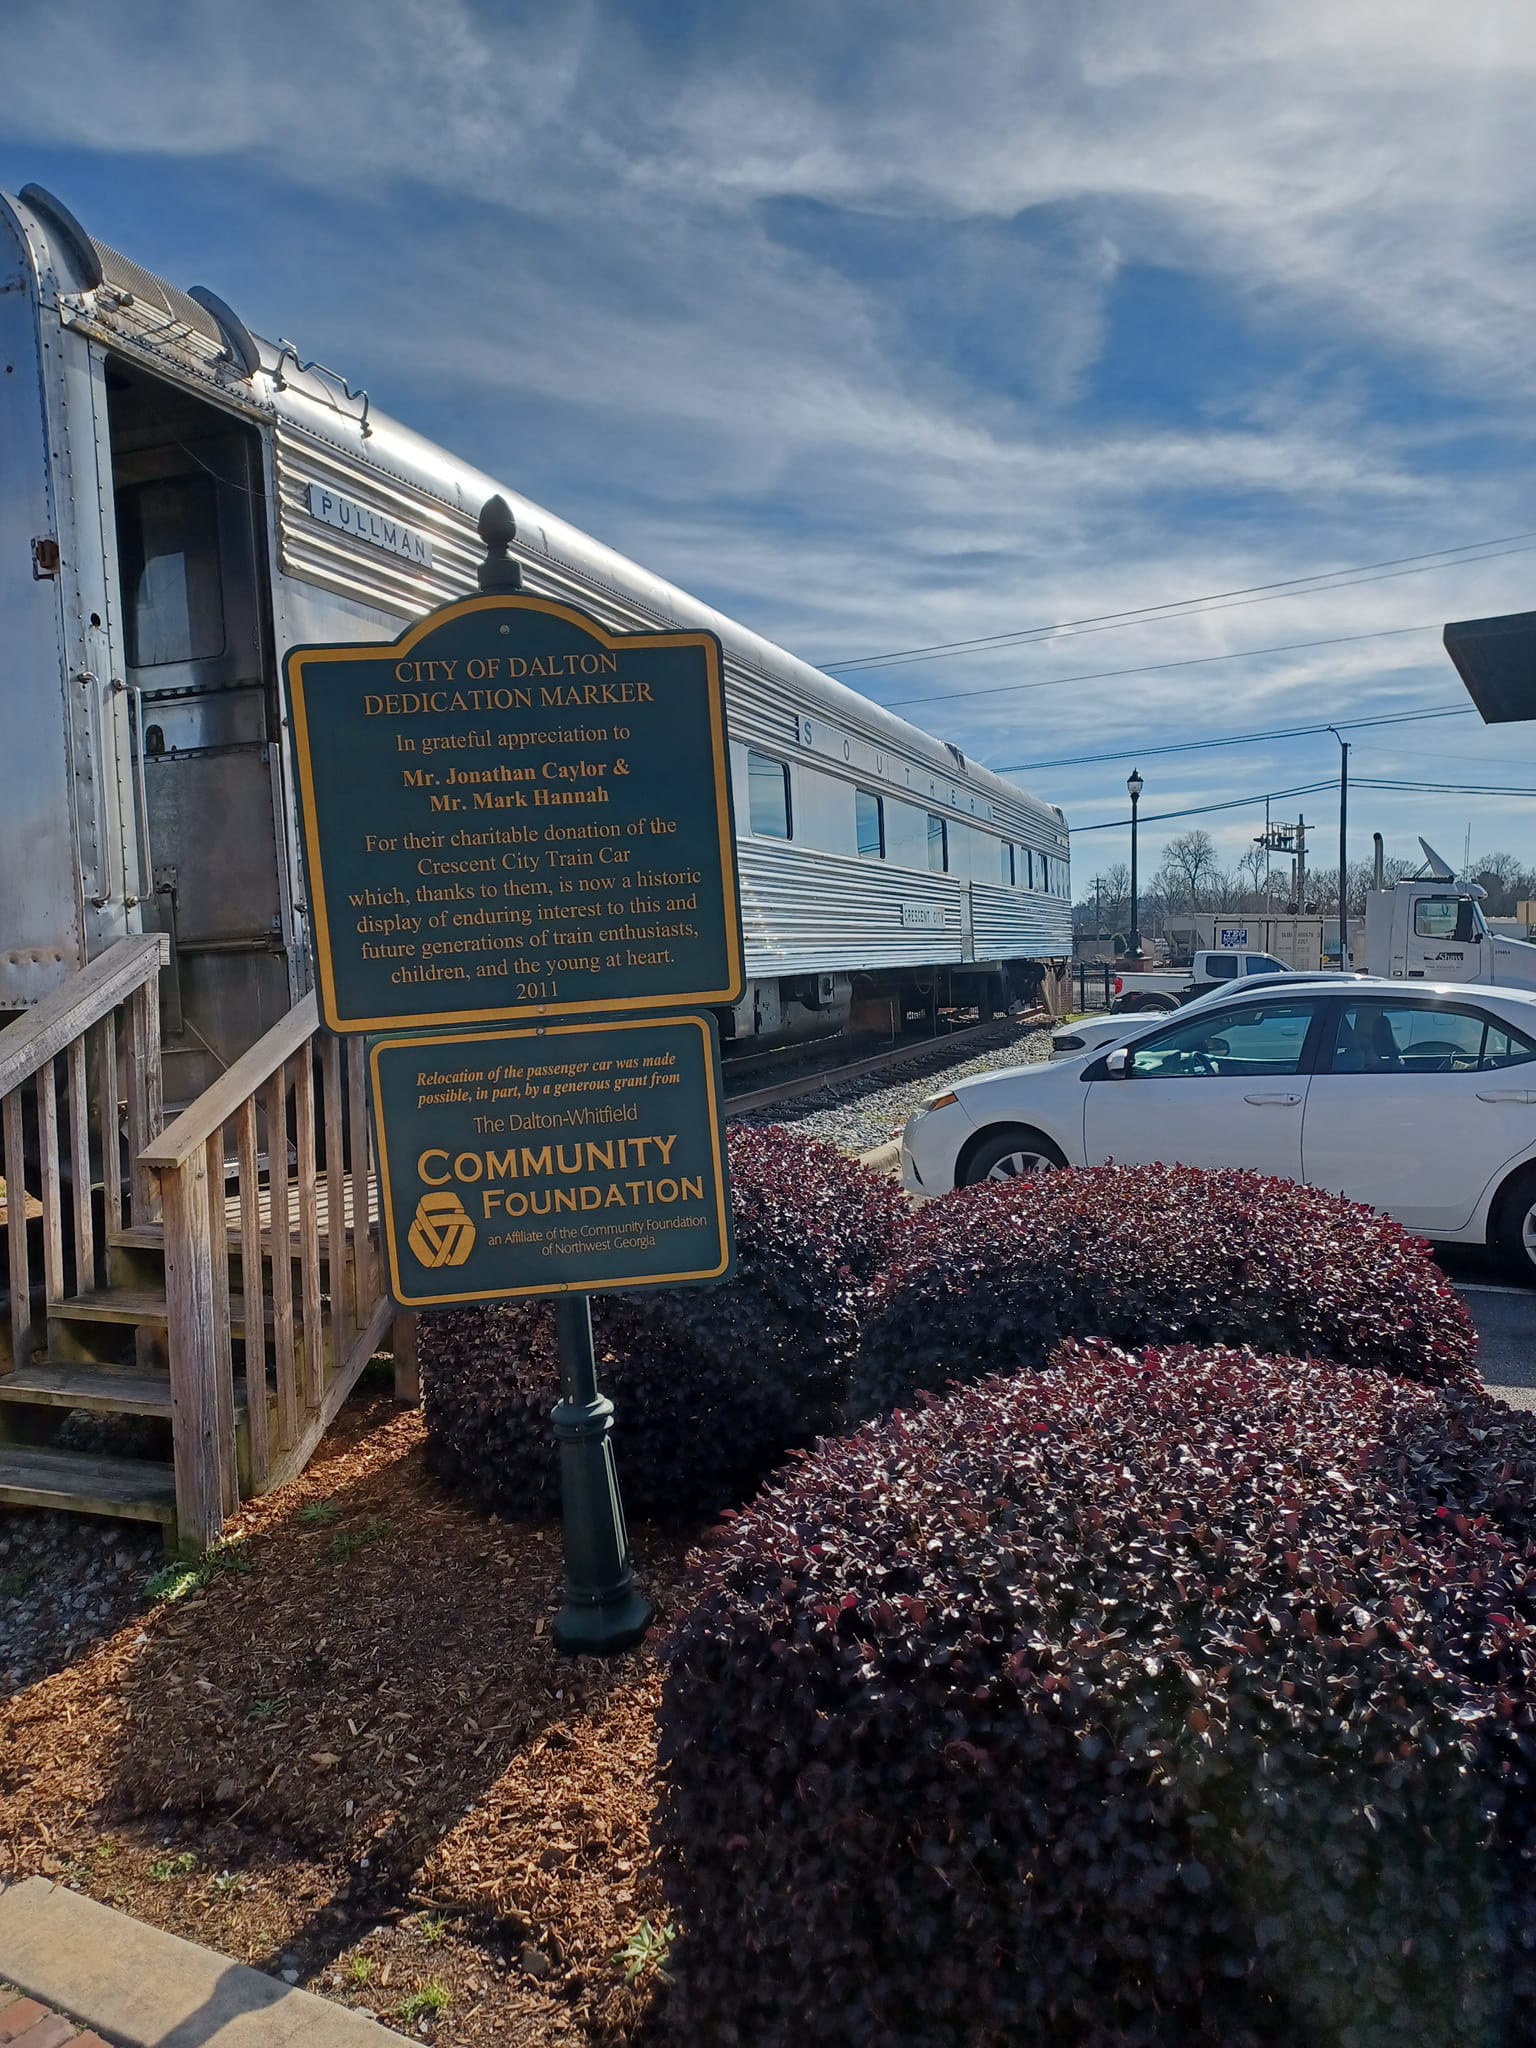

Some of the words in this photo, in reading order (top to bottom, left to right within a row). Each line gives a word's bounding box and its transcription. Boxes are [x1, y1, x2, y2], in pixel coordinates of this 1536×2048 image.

[321, 495, 426, 559] PULLMAN
[394, 660, 459, 683] CITY
[466, 658, 500, 680] OF
[508, 652, 618, 678] DALTON
[363, 688, 532, 717] DEDICATION
[539, 682, 654, 708] MARKER
[396, 734, 416, 752] In
[421, 729, 492, 755] grateful
[497, 725, 608, 750] appreciation
[612, 725, 631, 740] to
[402, 769, 440, 787] Mr.
[445, 764, 537, 785] Jonathan
[541, 759, 607, 783] Caylor
[612, 758, 631, 776] &
[429, 794, 468, 812] Mr.
[472, 790, 528, 809] Mark
[532, 786, 609, 806] Hannah
[365, 835, 398, 852] For
[402, 831, 446, 850] their
[450, 824, 538, 847] charitable
[544, 821, 621, 841] donation
[626, 819, 646, 835] of
[650, 817, 677, 834] the
[417, 857, 497, 876] Crescent
[502, 852, 540, 873] City
[545, 849, 594, 868] Train
[599, 847, 631, 864] Car
[348, 888, 411, 907] which,
[415, 883, 475, 903] thanks
[479, 882, 498, 898] to
[503, 879, 553, 897] them,
[559, 876, 574, 892] is
[579, 874, 616, 891] now
[622, 876, 632, 888] a
[636, 868, 701, 886] historic
[356, 916, 422, 937] display
[428, 912, 448, 928] of
[452, 906, 533, 927] enduring
[537, 902, 602, 921] interest
[607, 900, 624, 916] to
[629, 897, 661, 913] this
[666, 894, 698, 911] and
[904, 909, 930, 923] CRESCENT
[361, 941, 416, 960] future
[421, 934, 524, 958] generations
[529, 930, 549, 947] of
[553, 928, 593, 946] train
[598, 922, 699, 942] enthusiasts,
[1438, 952, 1464, 961] Shaw
[391, 962, 471, 984] children,
[476, 959, 509, 978] and
[513, 957, 541, 974] the
[545, 954, 601, 976] young
[606, 952, 622, 967] at
[626, 949, 675, 966] heart.
[516, 981, 559, 1000] 2011
[416, 1069, 484, 1087] Relocation
[487, 1067, 503, 1083] of
[503, 1066, 524, 1079] the
[526, 1061, 589, 1082] passenger
[592, 1060, 612, 1072] car
[616, 1056, 639, 1069] was
[642, 1052, 676, 1067] made
[417, 1088, 472, 1108] possible,
[476, 1085, 489, 1100] in
[491, 1085, 522, 1102] part,
[525, 1083, 540, 1098] by
[543, 1084, 551, 1096] a
[553, 1079, 612, 1098] generous
[614, 1074, 648, 1092] grant
[650, 1071, 680, 1090] from
[473, 1115, 505, 1135] The
[509, 1103, 638, 1132] Dalton-Whitfield
[417, 1134, 678, 1186] COMMUNITY
[482, 1175, 704, 1219] FOUNDATION
[488, 1234, 502, 1247] an
[504, 1229, 543, 1245] Affiliate
[545, 1228, 558, 1241] of
[560, 1227, 578, 1239] the
[580, 1222, 644, 1238] Community
[647, 1214, 707, 1232] Foundation
[542, 1243, 554, 1256] of
[554, 1239, 611, 1255] Northwest
[614, 1235, 656, 1251] Georgia
